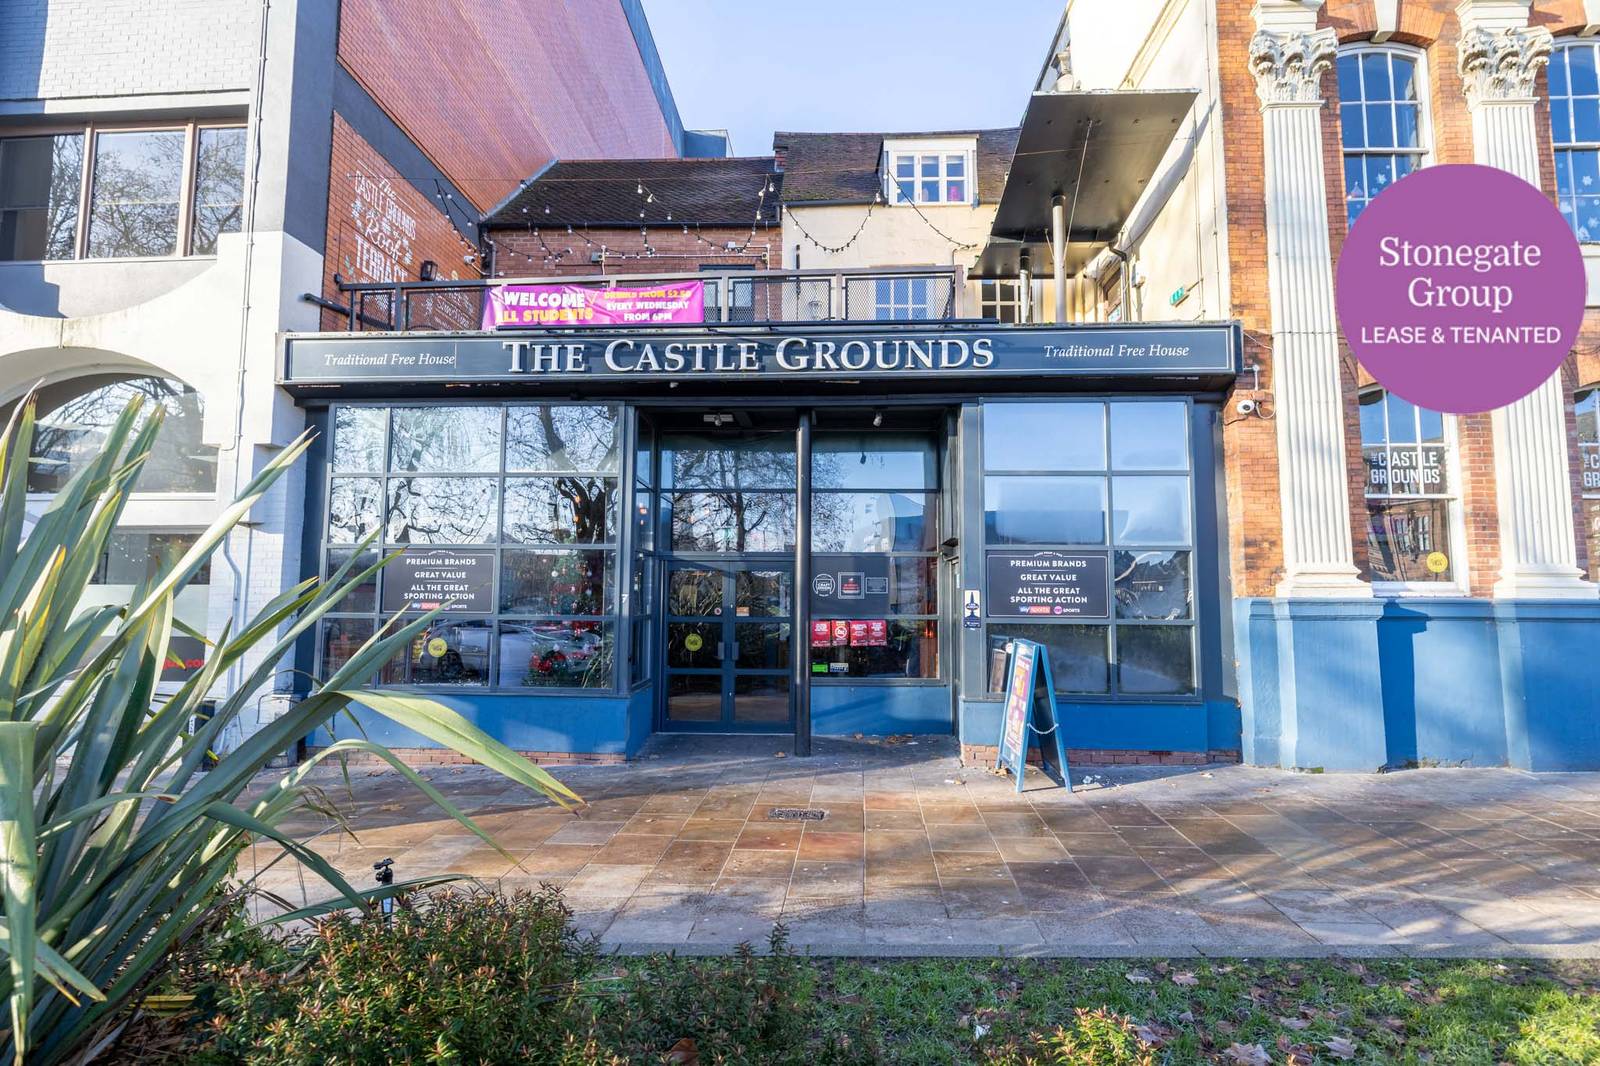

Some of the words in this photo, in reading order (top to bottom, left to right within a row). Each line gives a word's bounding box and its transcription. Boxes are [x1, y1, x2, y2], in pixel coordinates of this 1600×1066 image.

[354, 170, 385, 214] CASTLE
[386, 197, 417, 241] GROUNDS
[364, 214, 403, 264] Roof
[503, 291, 585, 308] WELCOME
[635, 300, 690, 310] WEDNESDAY
[522, 307, 594, 322] STUDENTS
[624, 312, 650, 321] FROM
[502, 340, 586, 373] THE
[604, 339, 761, 373] CASTLE
[775, 337, 994, 371] GROUNDS
[1044, 344, 1114, 358] Traditional
[1118, 344, 1146, 357] Free
[1148, 344, 1189, 357] House
[324, 353, 388, 366] Traditional
[391, 353, 415, 365] Free
[418, 353, 455, 366] House
[1378, 451, 1438, 467] CASTLE
[1370, 468, 1441, 485] GROUNDS
[406, 558, 442, 566] PREMIUM
[445, 558, 476, 566] BRANDS
[414, 571, 440, 579] GREAT
[442, 571, 467, 579] VALUE
[404, 592, 443, 600] SPORTING
[445, 592, 475, 600] ACTION
